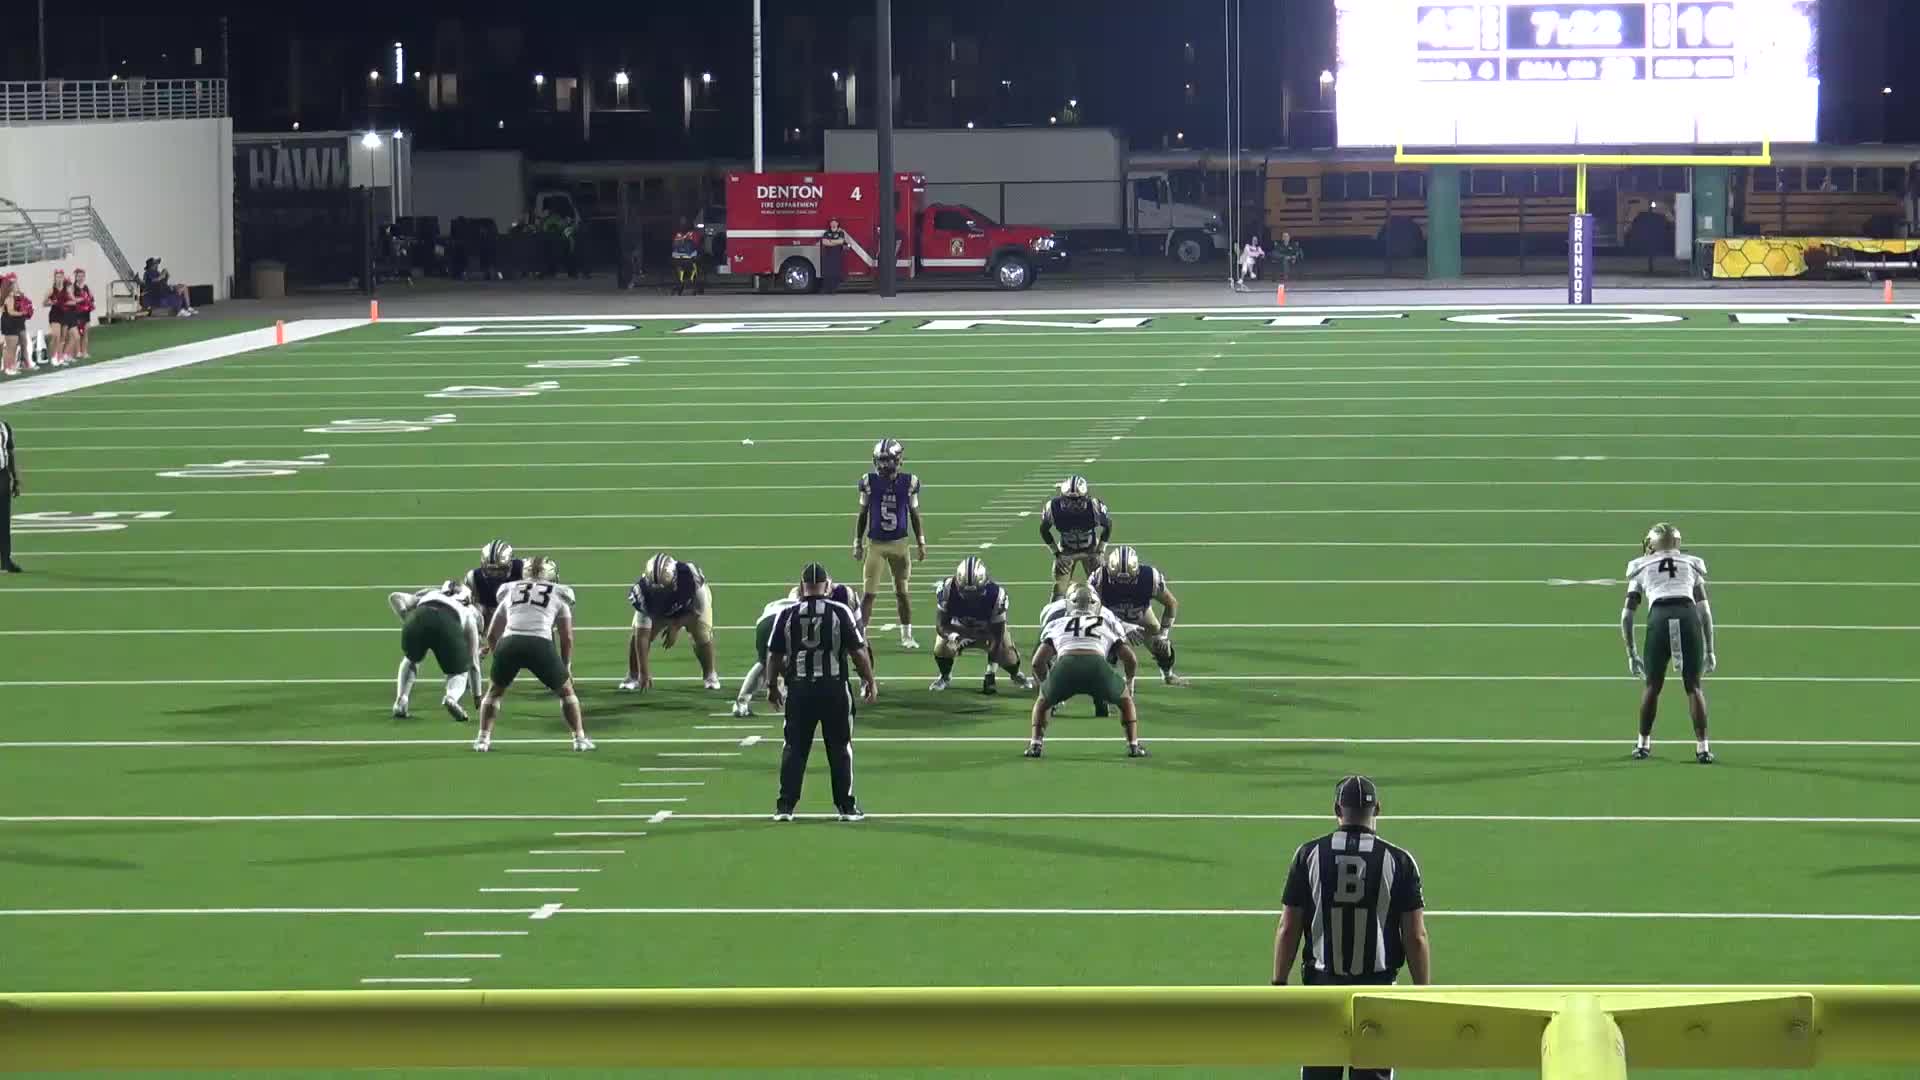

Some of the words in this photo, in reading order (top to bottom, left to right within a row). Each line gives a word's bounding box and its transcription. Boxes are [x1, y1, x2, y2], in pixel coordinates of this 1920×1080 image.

[756, 185, 823, 199] DENTON
[850, 186, 862, 201] 4
[1574, 216, 1583, 304] BRONCOS
[880, 502, 898, 531] 5
[1658, 557, 1678, 579] 4
[511, 583, 553, 609] 33
[799, 616, 823, 649] U
[1064, 615, 1104, 638] 42
[1334, 854, 1367, 903] B
